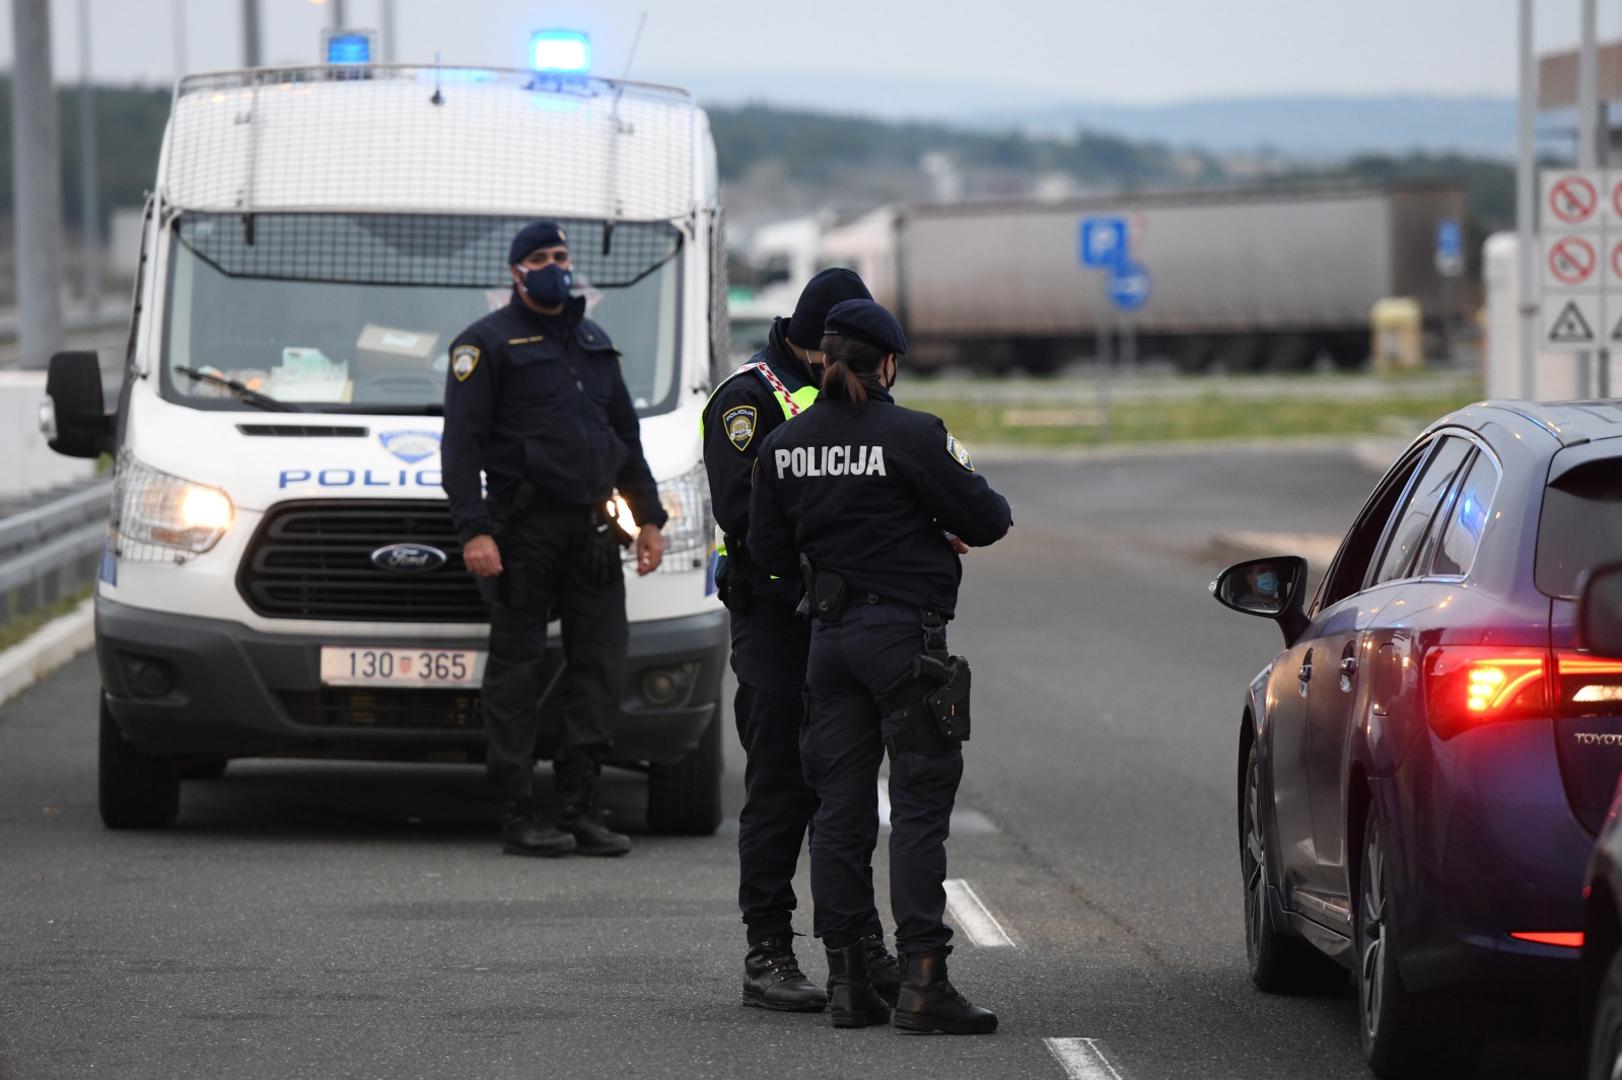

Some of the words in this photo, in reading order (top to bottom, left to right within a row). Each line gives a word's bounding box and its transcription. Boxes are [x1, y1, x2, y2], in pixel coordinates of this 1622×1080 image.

[775, 446, 887, 479] POLICIJA
[279, 469, 442, 488] POLIC
[388, 548, 429, 567] Ford
[350, 652, 394, 678] 130
[418, 653, 467, 680] 365
